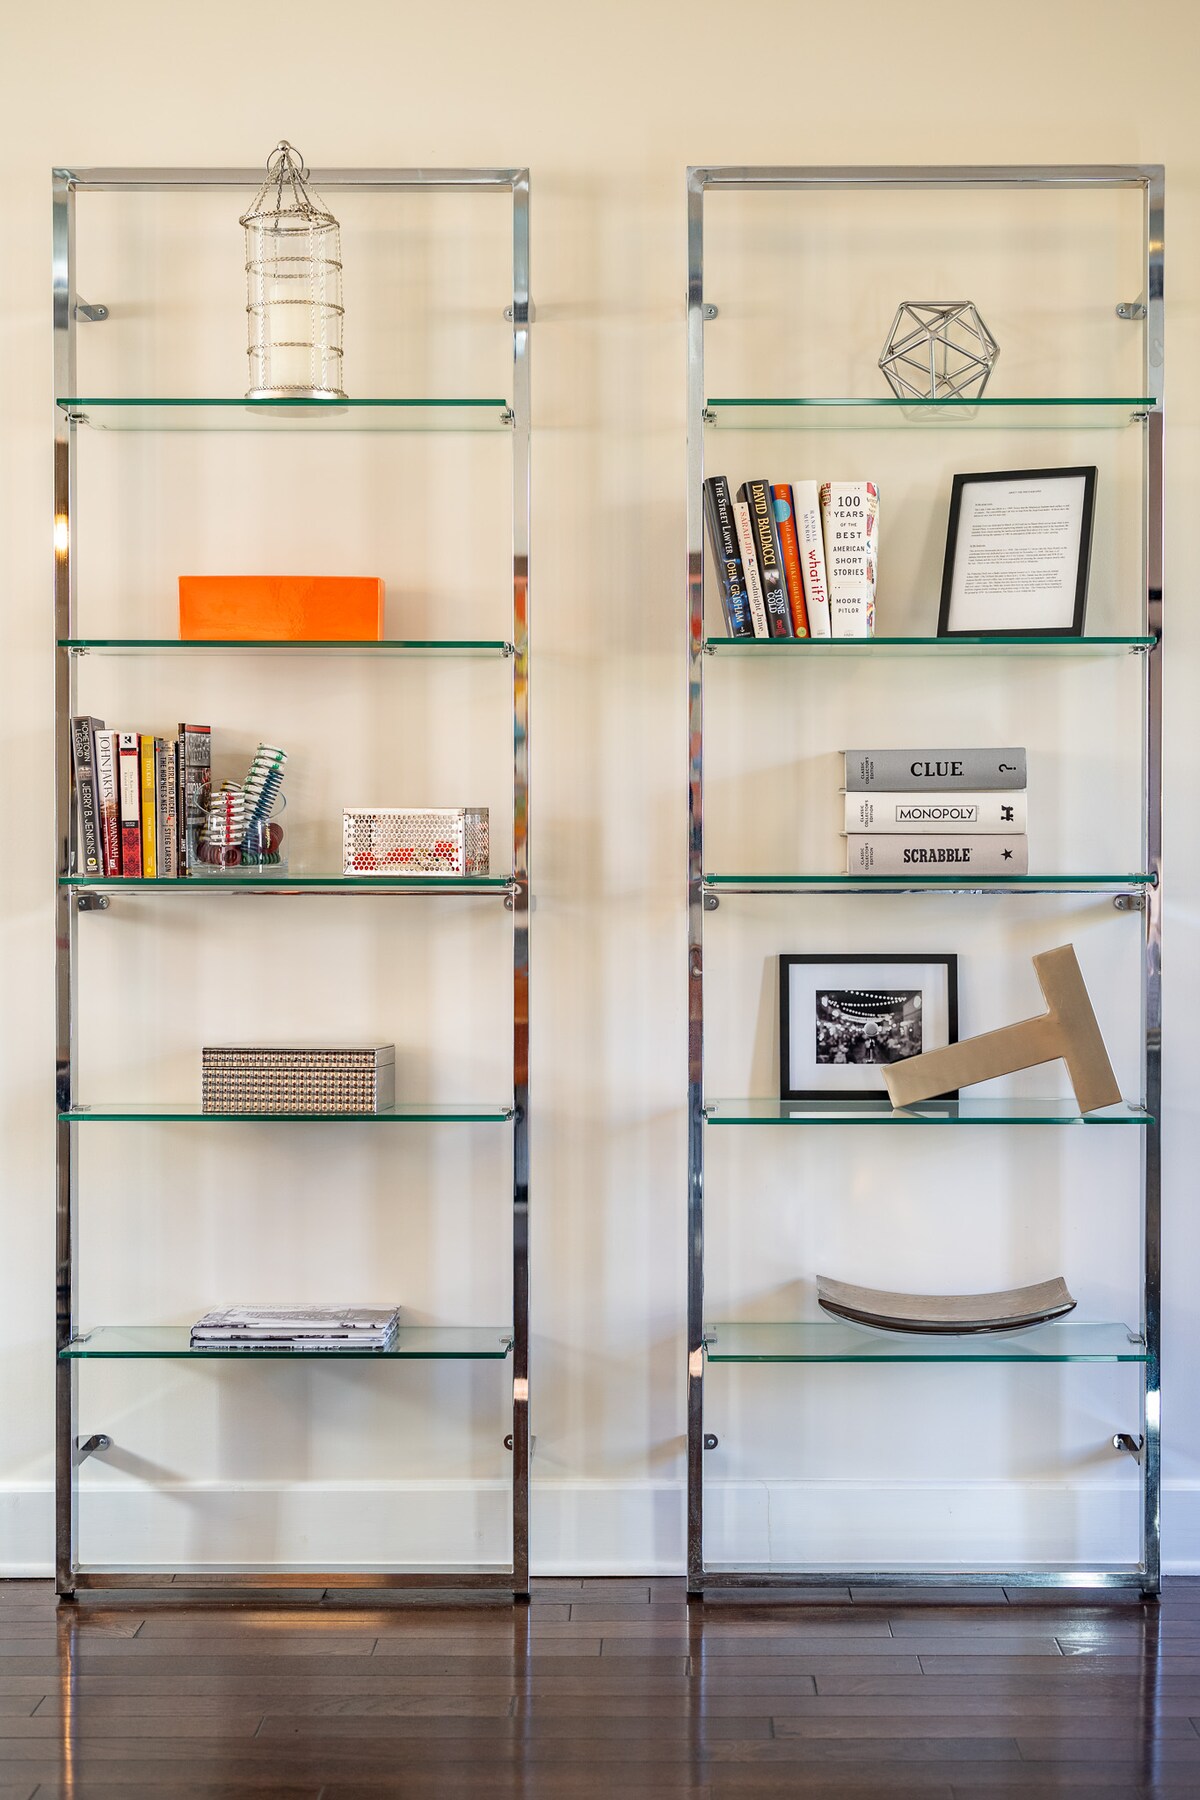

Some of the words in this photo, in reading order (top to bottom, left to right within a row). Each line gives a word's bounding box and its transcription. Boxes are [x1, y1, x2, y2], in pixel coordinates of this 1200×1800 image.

[715, 481, 724, 497] THE
[752, 484, 768, 514] DAVID
[838, 496, 860, 507] 100
[718, 498, 728, 524] STREET
[741, 511, 750, 539] SARAH
[722, 526, 733, 555] LAWYER
[758, 517, 776, 566] BALDACCI
[724, 558, 738, 582] JOHN
[808, 550, 821, 582] what
[730, 584, 744, 623] GRISHAM
[750, 570, 762, 611] Goodnight
[767, 592, 777, 614] COLD
[774, 589, 786, 614] STONE
[812, 586, 824, 602] if?
[82, 722, 90, 762] HOMETOWN
[99, 736, 111, 766] JOHN
[911, 762, 963, 776] CLUE
[82, 783, 92, 809] JERRY
[100, 769, 113, 798] JAKES
[900, 808, 974, 819] MONOPOLY
[85, 819, 95, 854] JENKINS
[110, 817, 119, 858] SAVANNAH
[904, 848, 970, 863] SCRABBLE
